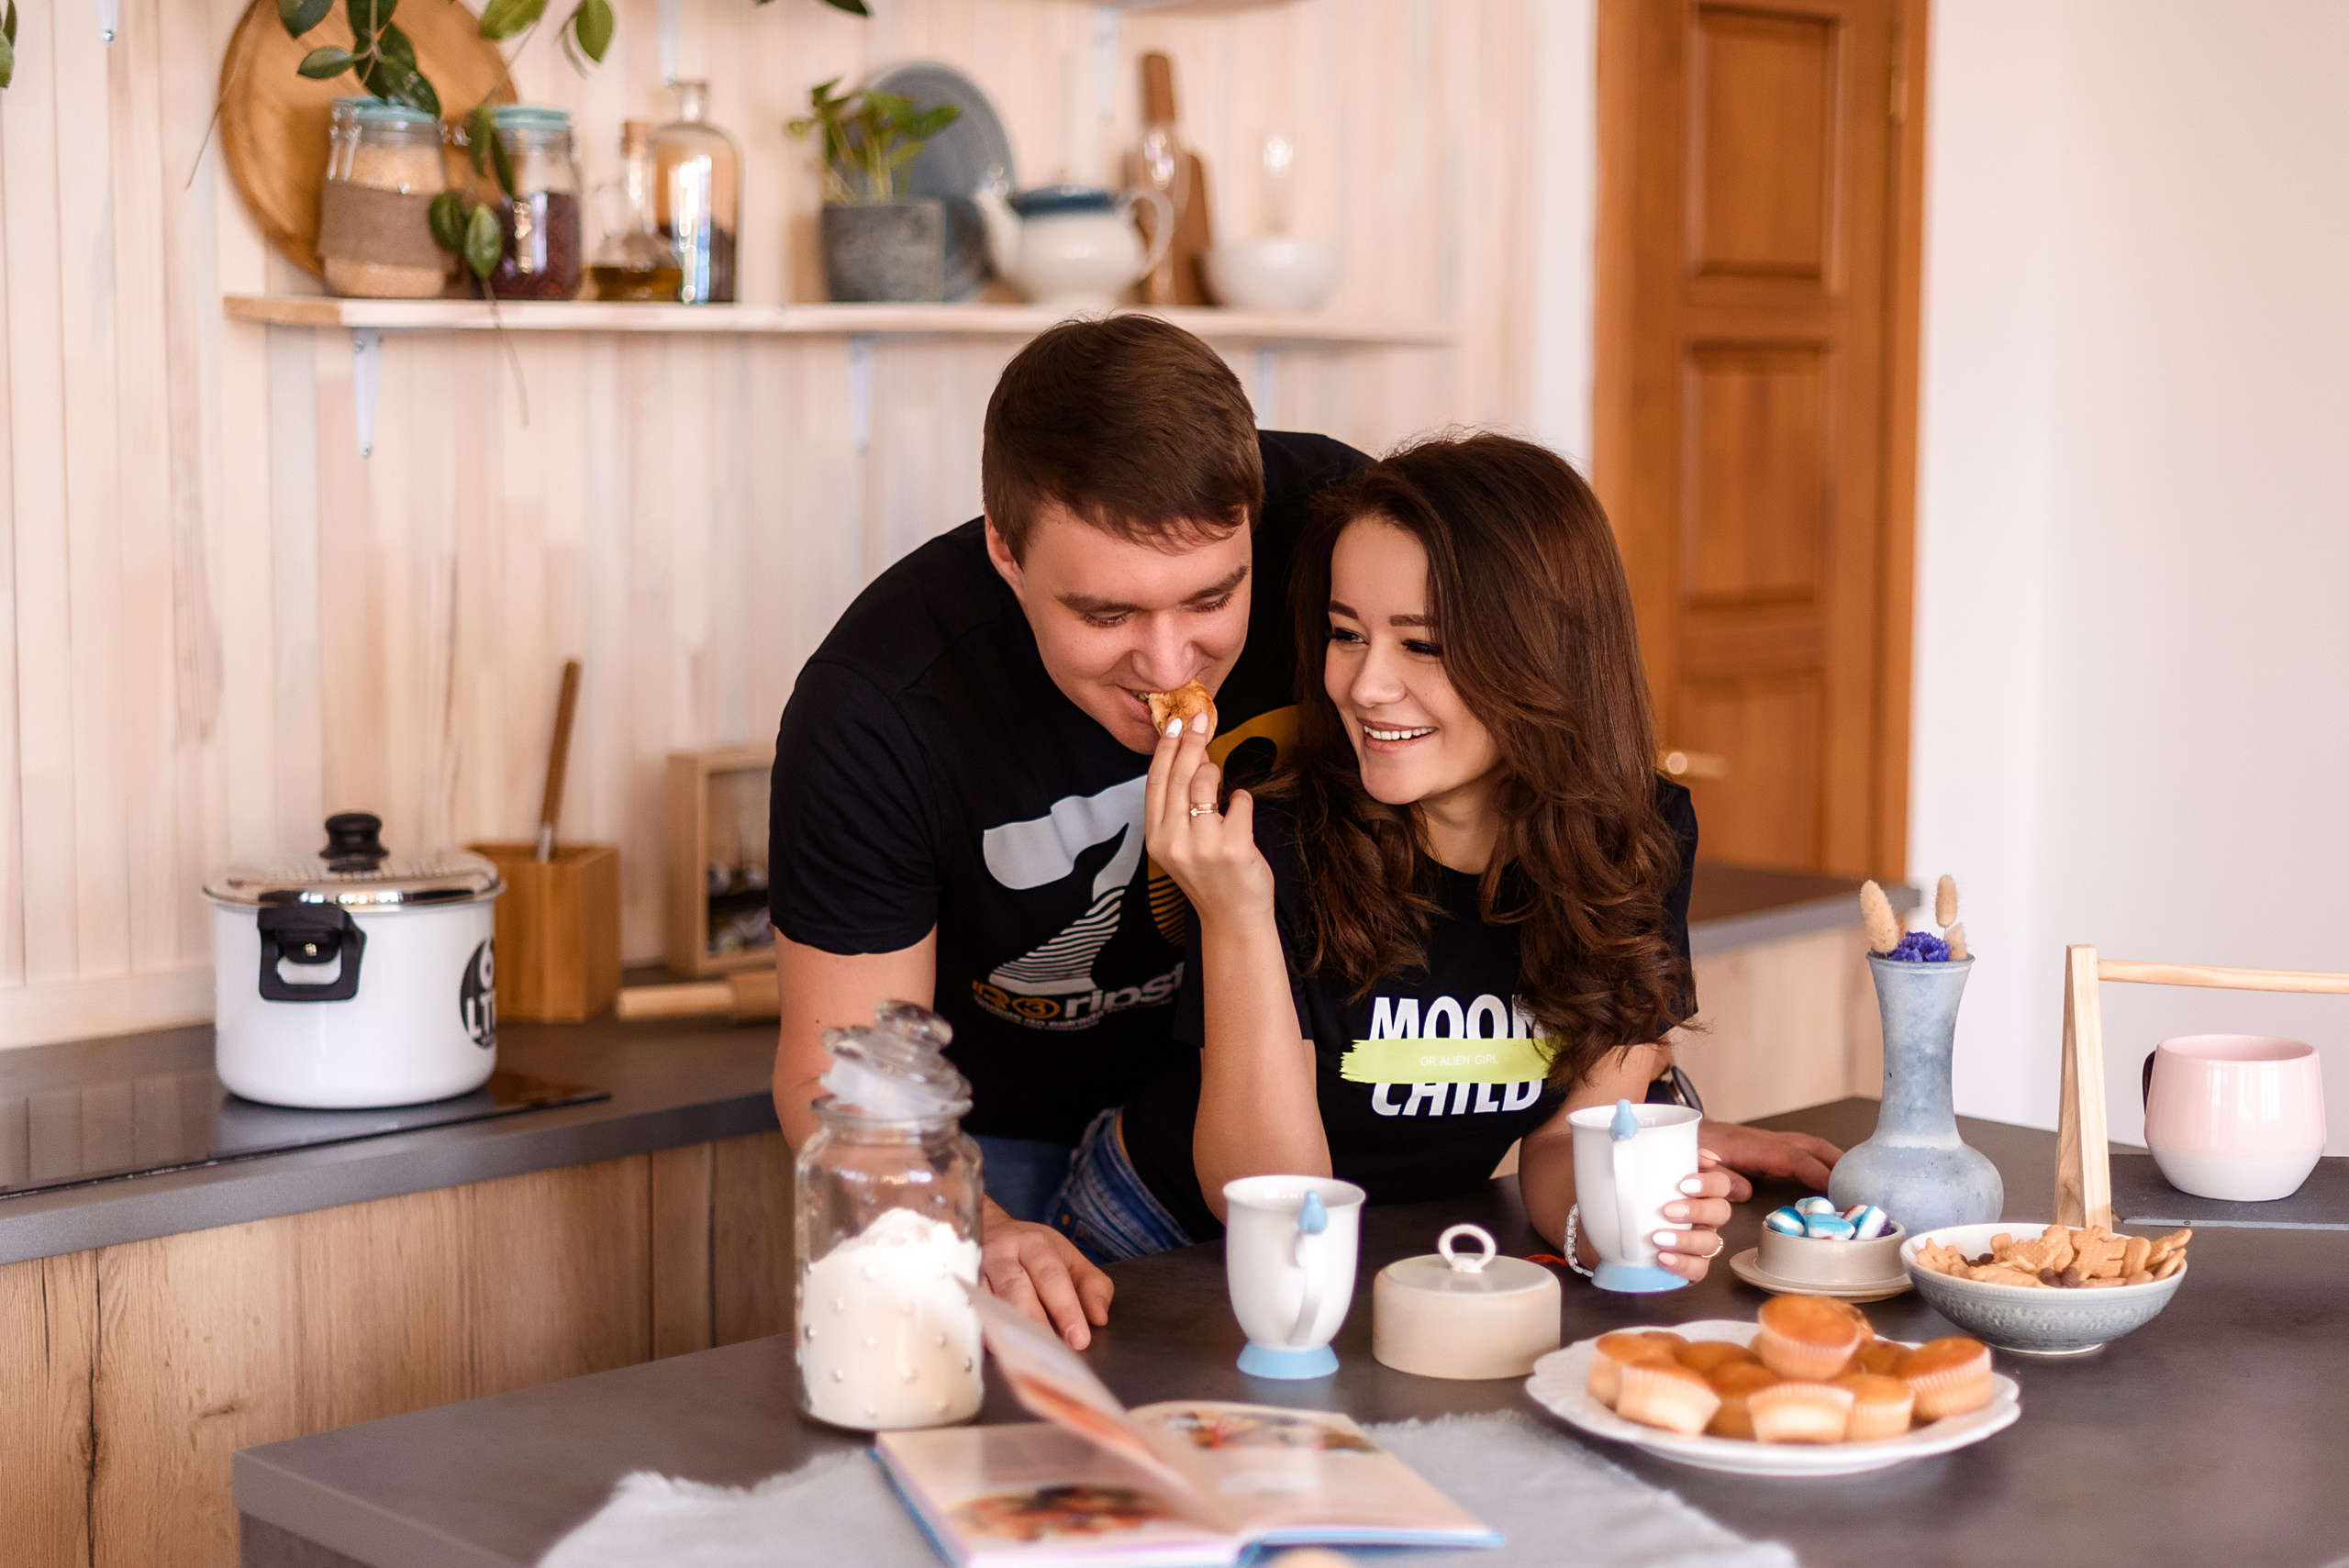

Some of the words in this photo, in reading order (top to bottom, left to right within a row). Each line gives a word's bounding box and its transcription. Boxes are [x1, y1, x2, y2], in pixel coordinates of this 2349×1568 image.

[1419, 1055, 1437, 1067] OR
[1439, 1055, 1471, 1066] ALIEN
[1474, 1053, 1499, 1065] GIRL
